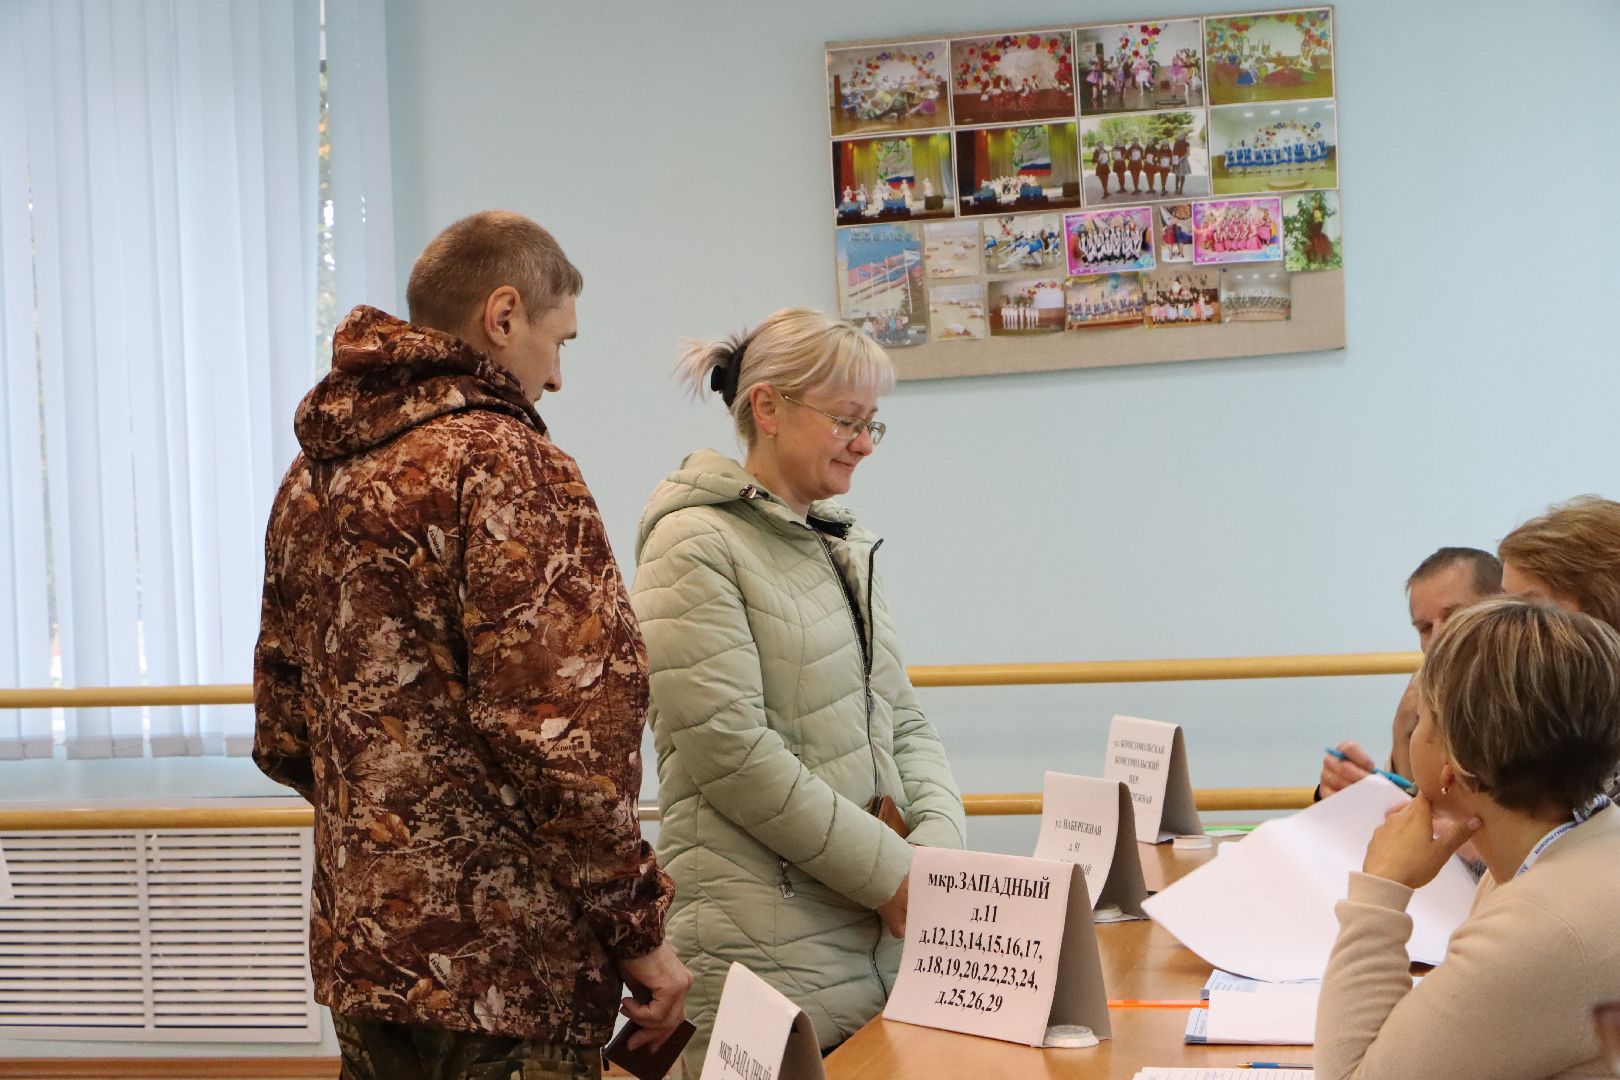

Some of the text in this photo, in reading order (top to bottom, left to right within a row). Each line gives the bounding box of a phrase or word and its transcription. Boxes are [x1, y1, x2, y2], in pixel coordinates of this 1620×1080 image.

[927, 871, 1051, 900] мкр.ЗАПАДНЫЙ
[970, 904, 998, 923] д.11
[919, 926, 1043, 963] д.12,13,14,15,16,17,
[913, 955, 1038, 991] д.18,19,20,22,23,24,
[934, 987, 1003, 1014] д.25,26,29
